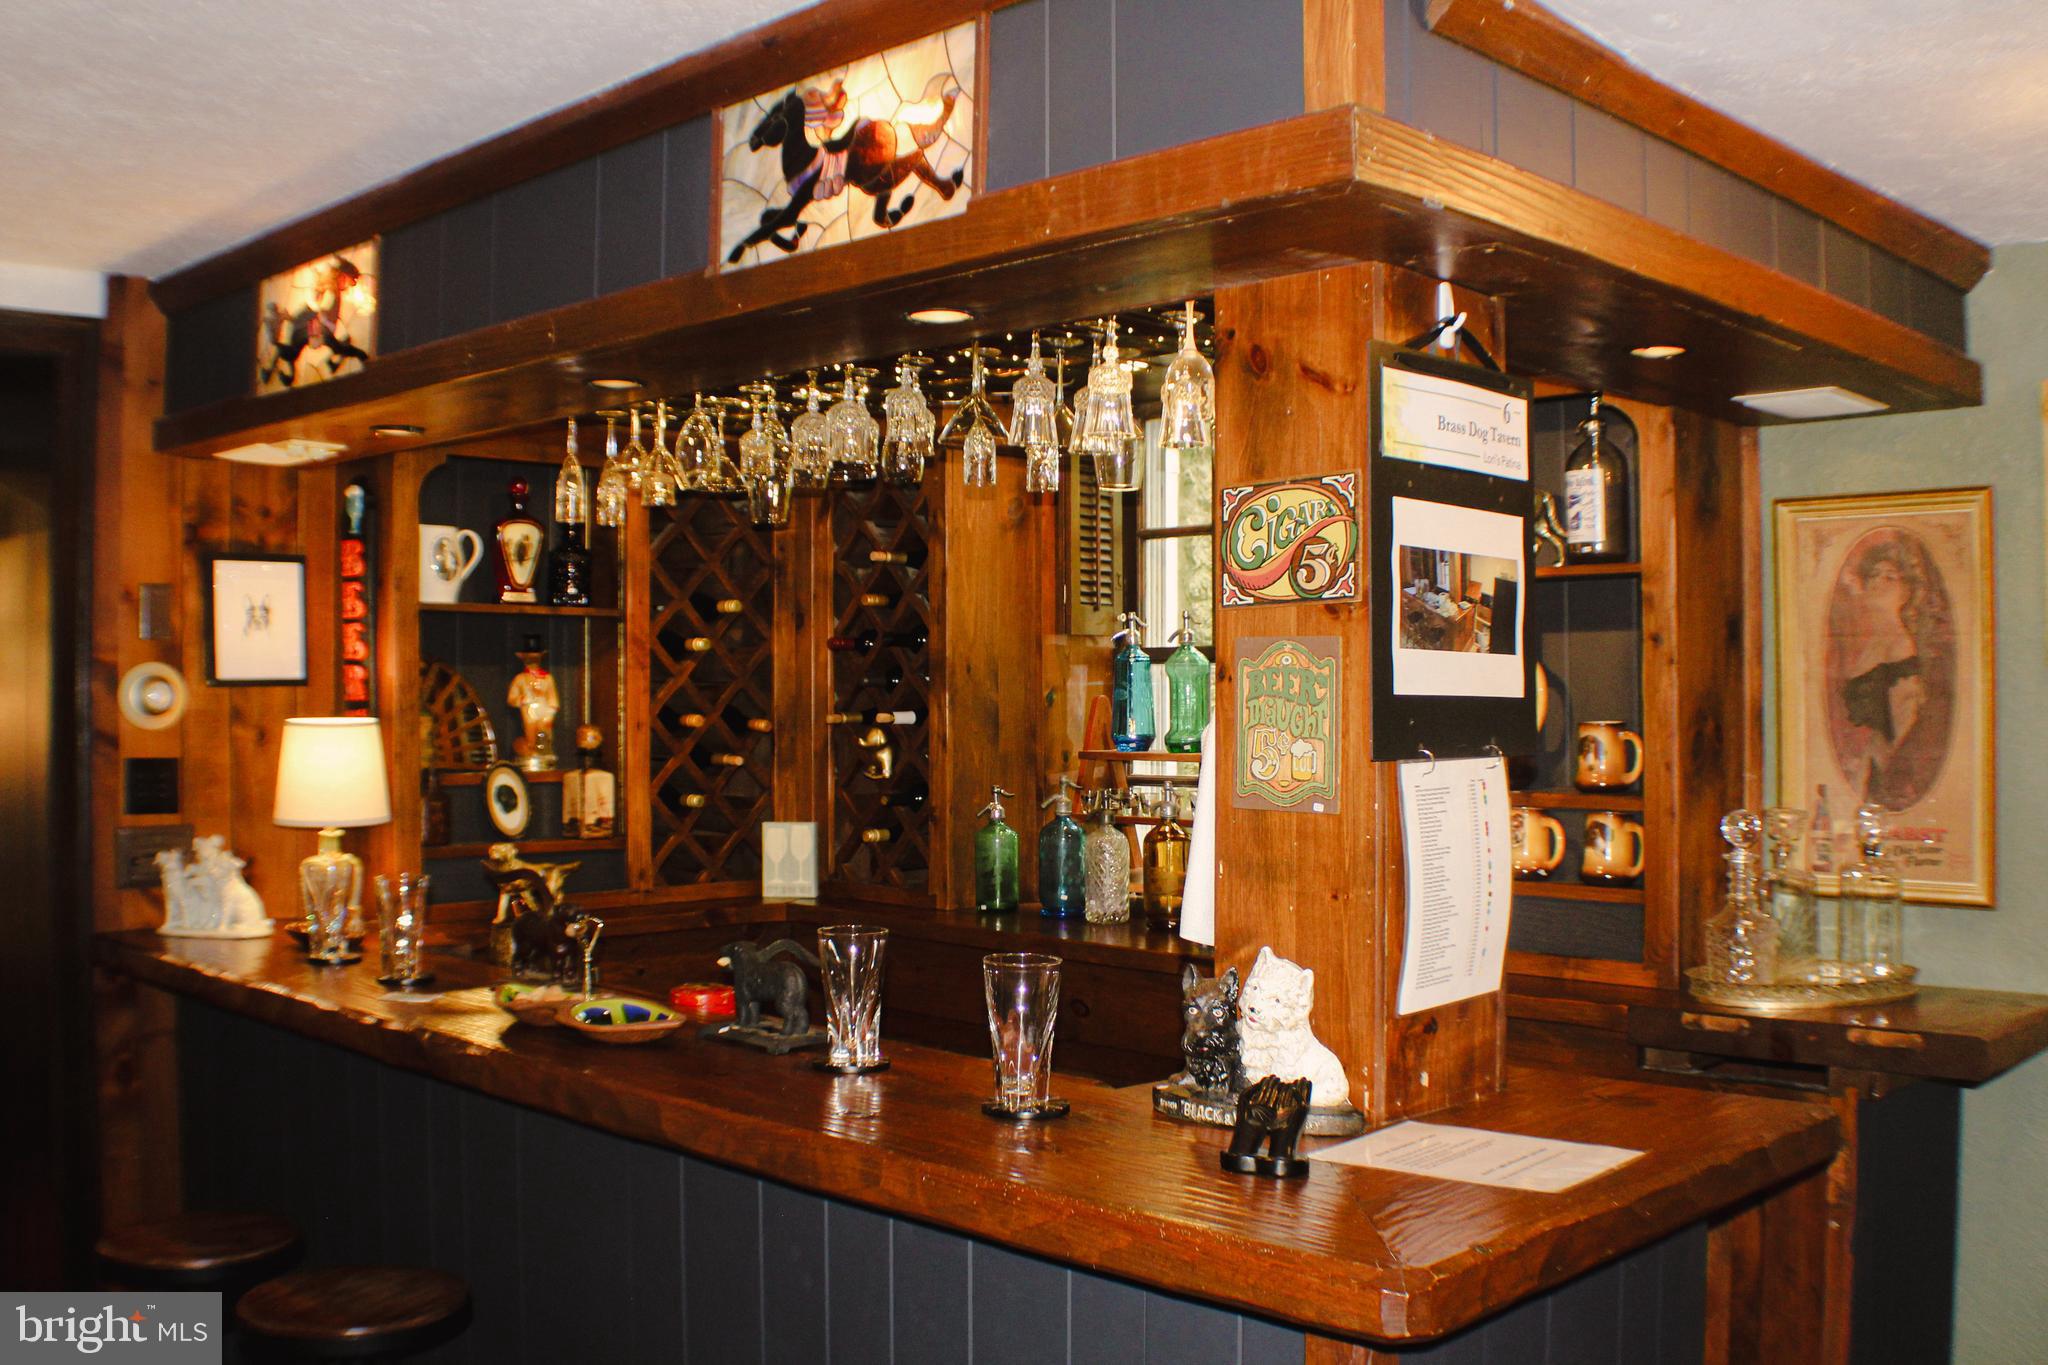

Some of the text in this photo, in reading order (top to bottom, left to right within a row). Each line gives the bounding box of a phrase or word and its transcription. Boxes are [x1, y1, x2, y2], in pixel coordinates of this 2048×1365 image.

[1437, 415, 1521, 447] Brass Dog Tavern
[1503, 402, 1511, 424] 6
[340, 539, 369, 717] BEER
[1246, 668, 1329, 706] BEER
[1250, 729, 1290, 781] 5¢
